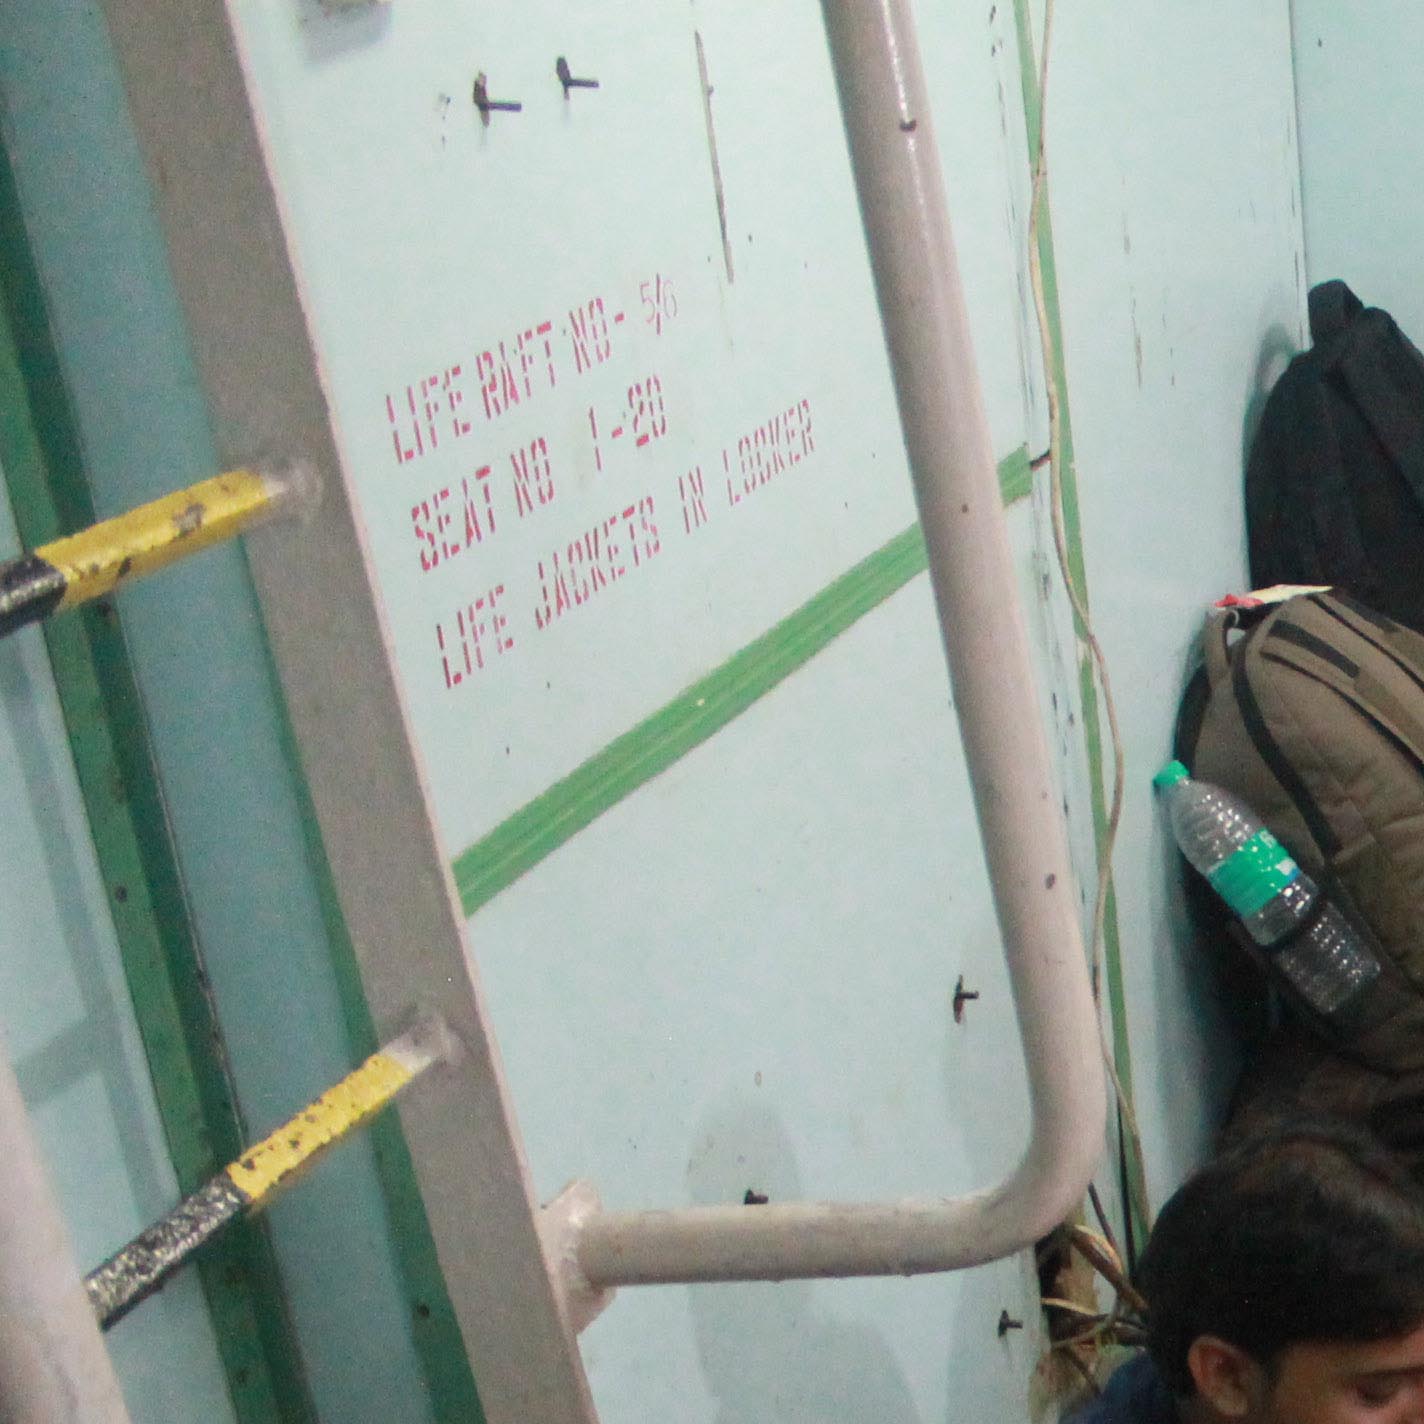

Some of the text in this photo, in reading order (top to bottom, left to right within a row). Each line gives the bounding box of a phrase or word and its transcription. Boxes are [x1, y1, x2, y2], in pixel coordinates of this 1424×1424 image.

[385, 365, 472, 465] LIFE
[476, 320, 557, 421] RAFT
[410, 465, 497, 573] SEAT
[509, 436, 555, 519] NO
[435, 398, 816, 690] LIFE JACKETS IN LOCKER
